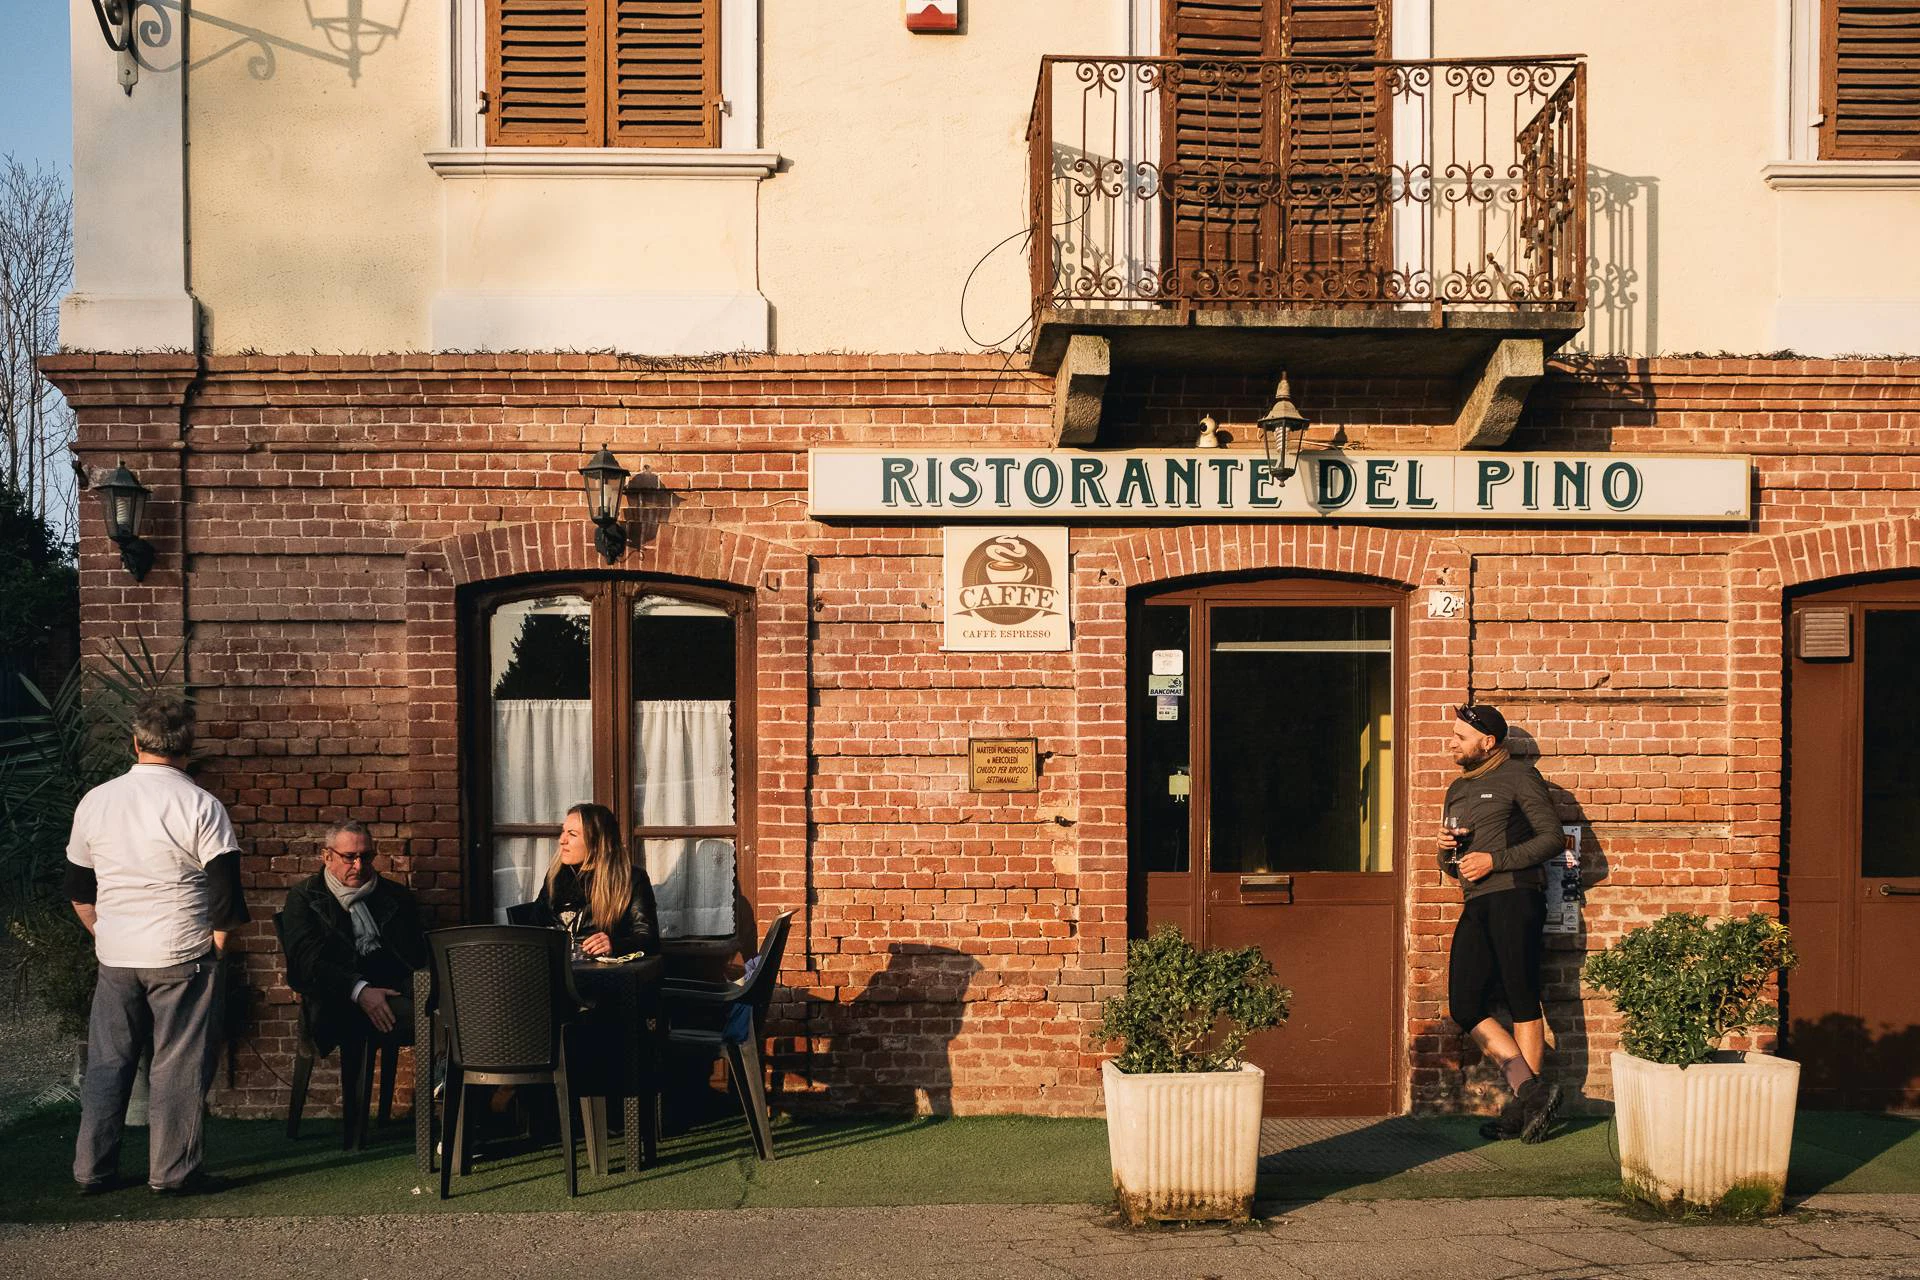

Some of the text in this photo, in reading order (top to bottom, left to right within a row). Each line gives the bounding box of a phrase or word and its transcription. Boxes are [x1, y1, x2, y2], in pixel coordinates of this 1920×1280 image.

[881, 457, 1643, 512] RISTORANTE DEL PINO
[1000, 630, 1051, 638] ESPRESSO
[997, 746, 1029, 754] POMERIGGIO
[976, 766, 1029, 774] CHIUSO PER RIPOSO
